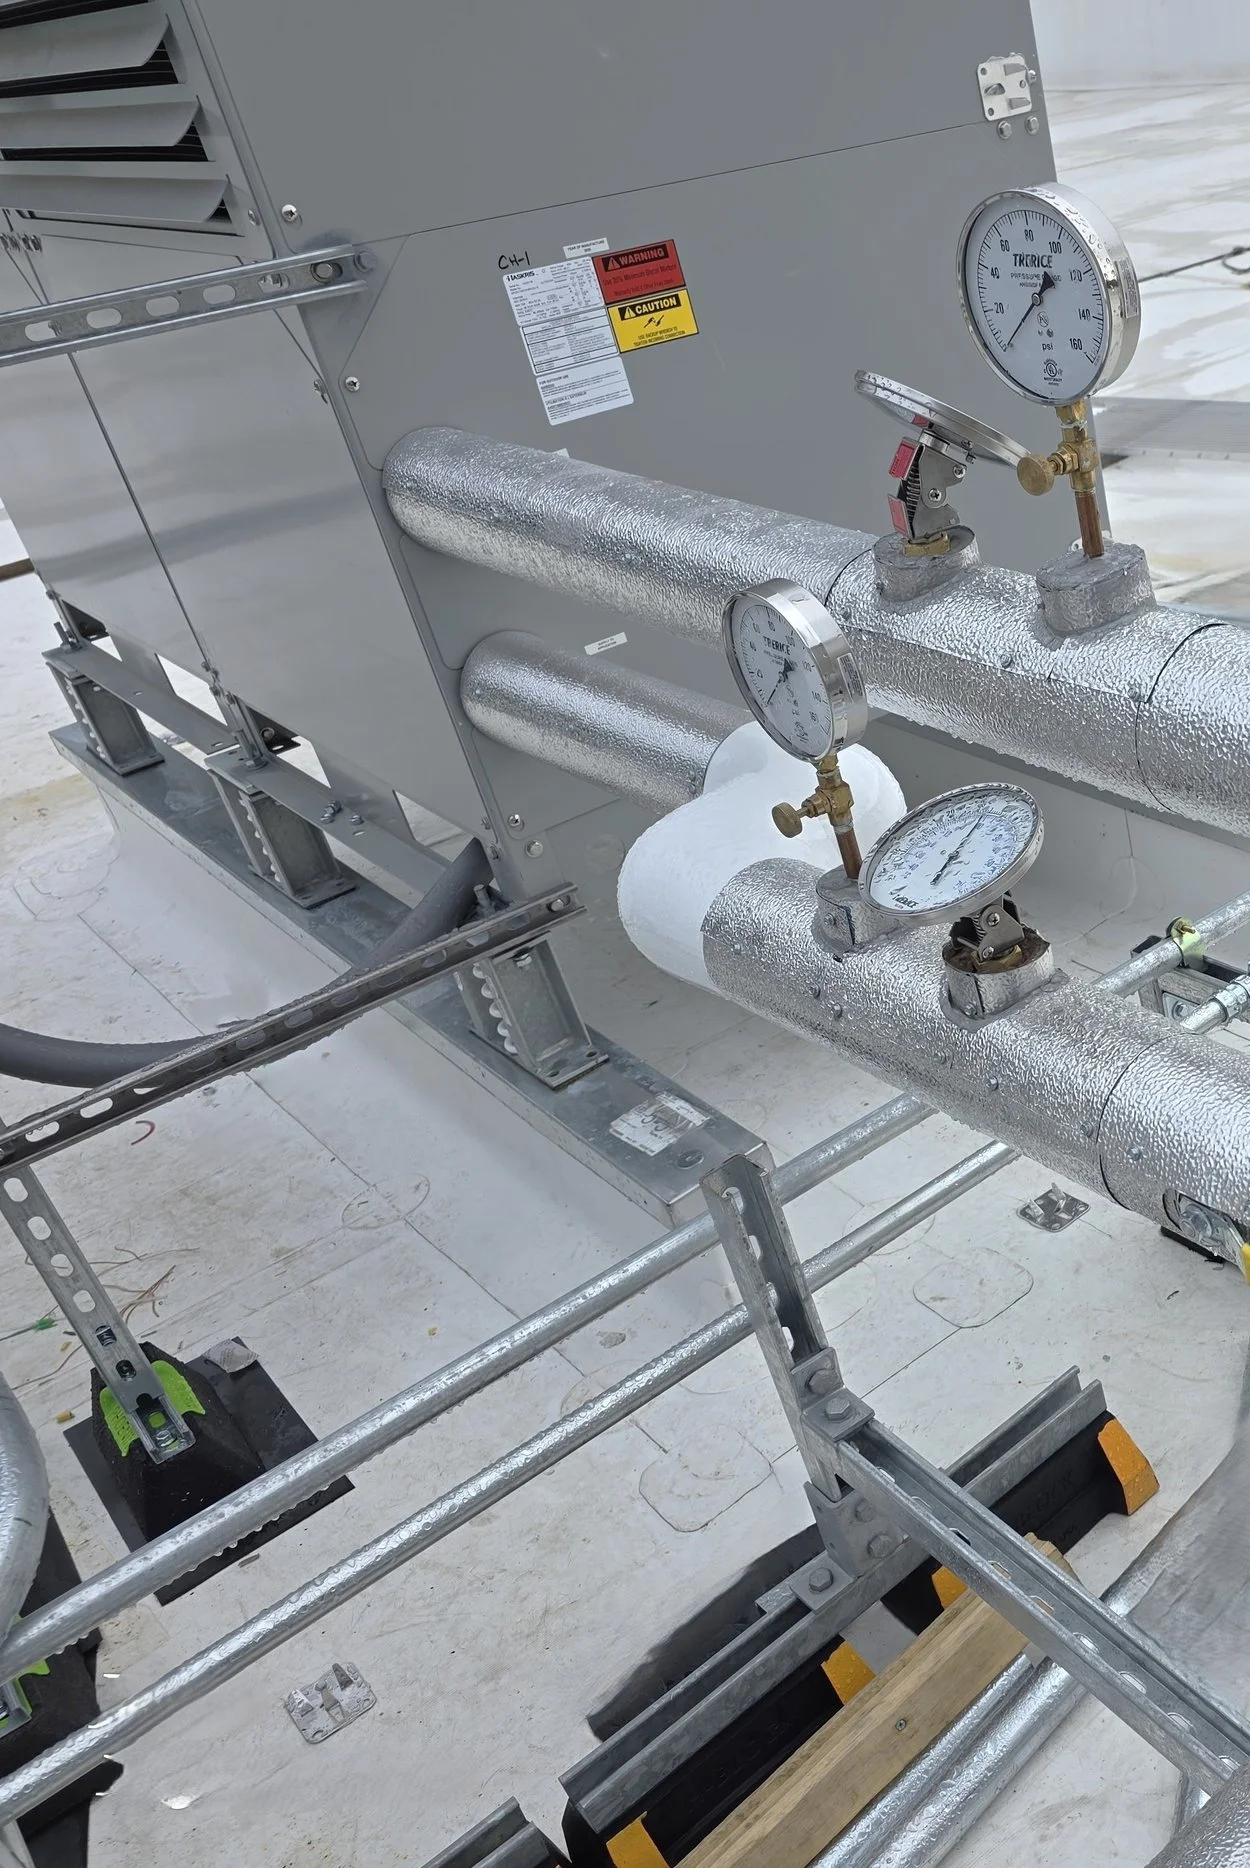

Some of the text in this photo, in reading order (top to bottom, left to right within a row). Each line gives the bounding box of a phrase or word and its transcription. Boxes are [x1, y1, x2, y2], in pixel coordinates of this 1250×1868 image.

[1024, 229, 1035, 242] 80
[1000, 239, 1011, 252] 60
[1048, 241, 1063, 254] 100
[498, 250, 531, 270] CH-1
[618, 248, 665, 266] WARNING
[1012, 252, 1053, 269] TRERICE
[990, 267, 1000, 280] 40
[1068, 269, 1083, 283] 120
[635, 297, 677, 315] CAUTION
[994, 302, 1005, 315] 20
[1078, 308, 1091, 321] 140
[1042, 342, 1054, 352] psi
[1069, 338, 1083, 351] 160
